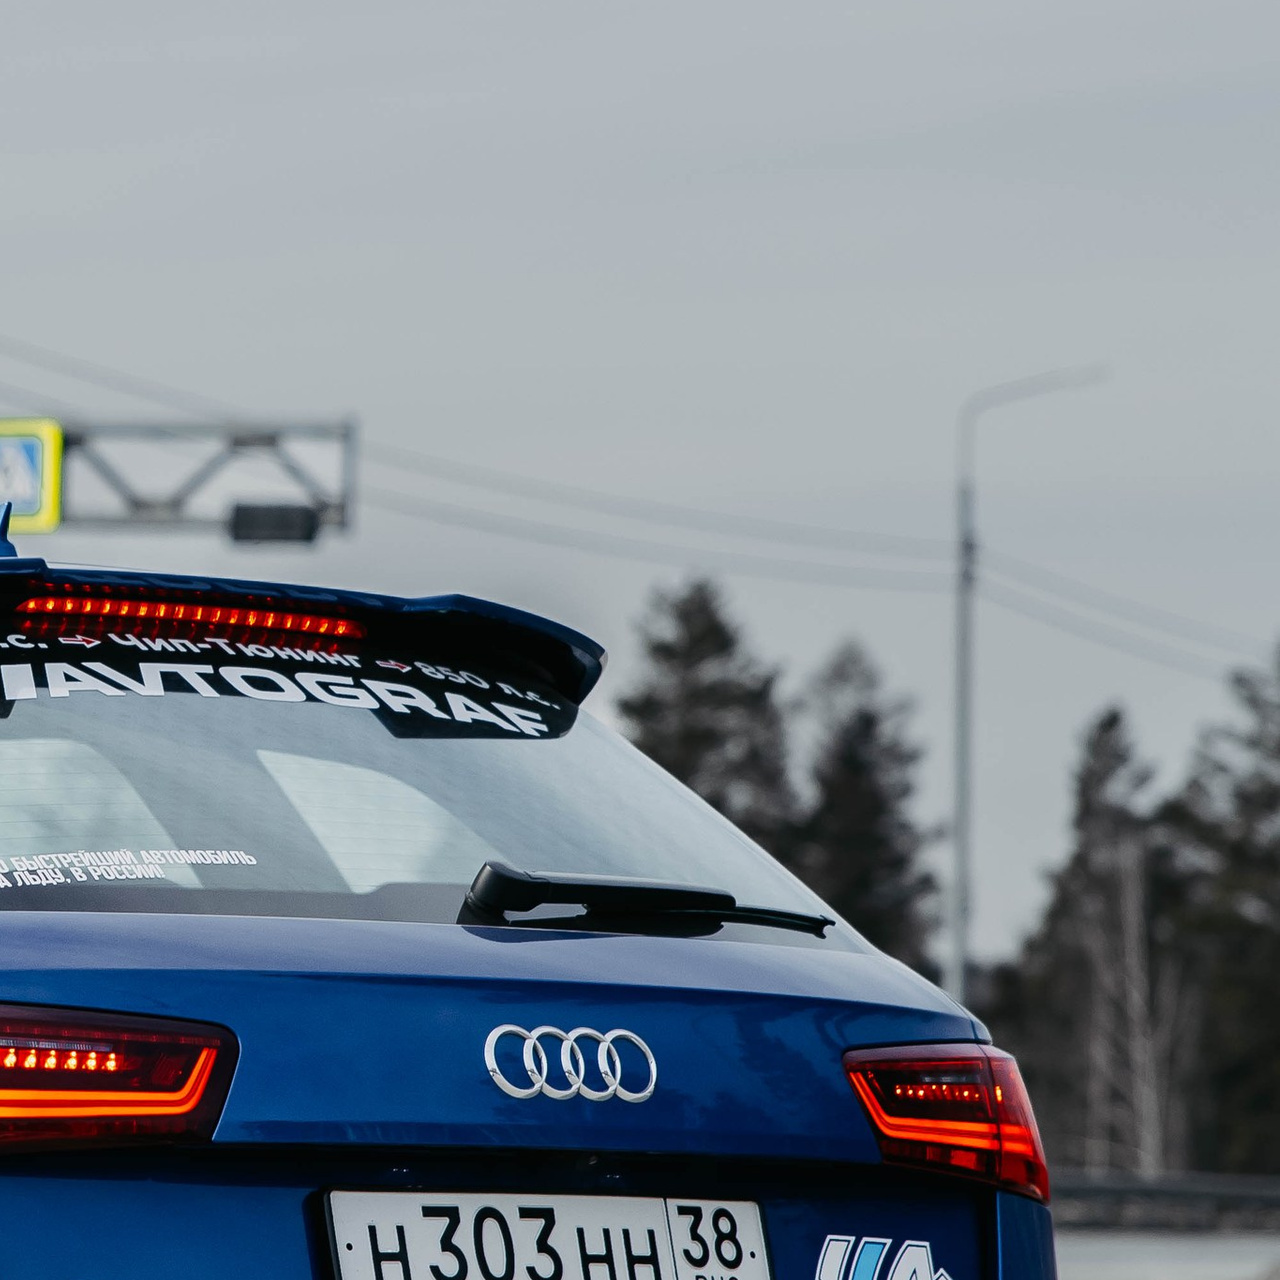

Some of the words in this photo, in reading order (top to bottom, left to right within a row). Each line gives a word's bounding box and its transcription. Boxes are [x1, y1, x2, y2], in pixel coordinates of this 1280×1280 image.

[414, 661, 490, 689] 850
[43, 661, 549, 737] AVTOGRAF
[10, 848, 137, 871] БЫСТРЕЙШИЙ
[140, 849, 258, 865] АВТОМОБИЛЬ
[12, 867, 71, 887] ЛЬДУ,
[70, 866, 88, 882] В
[88, 863, 166, 881] РОССИИ!
[676, 1205, 743, 1269] 38
